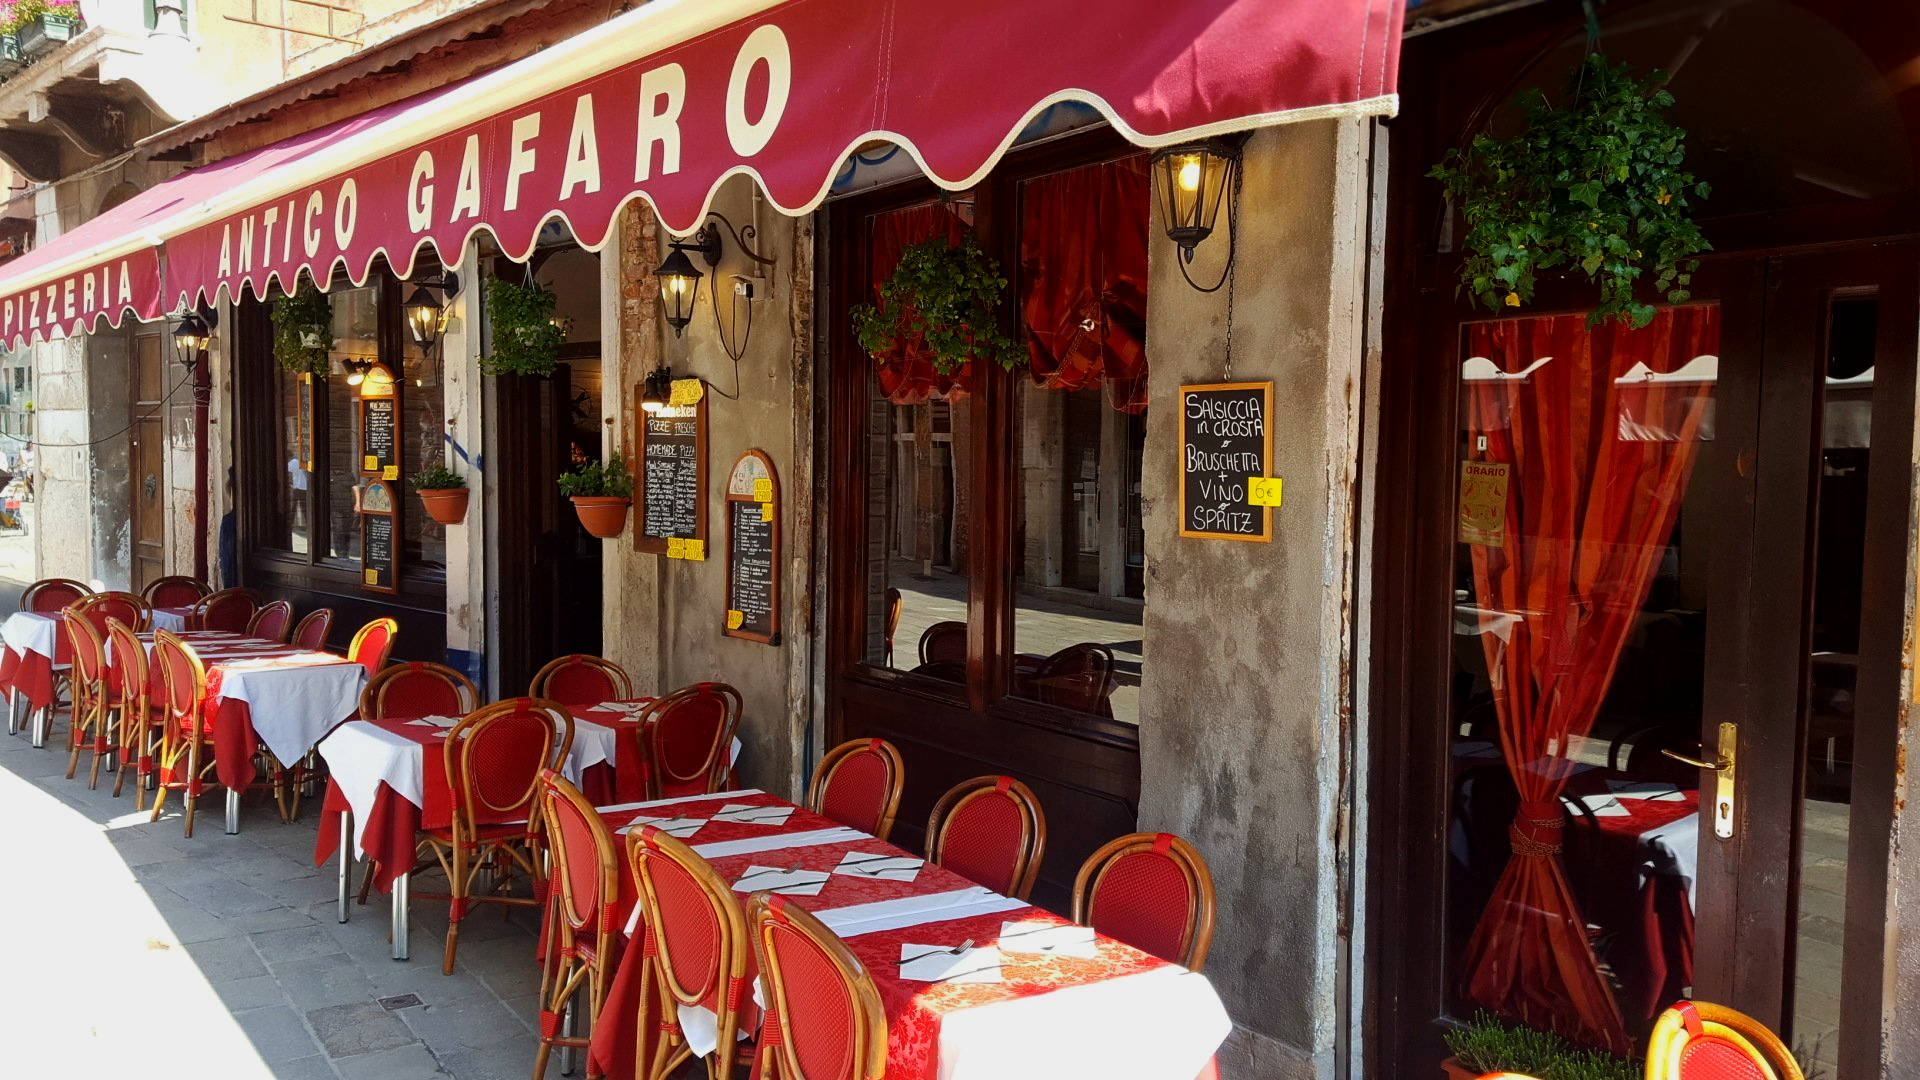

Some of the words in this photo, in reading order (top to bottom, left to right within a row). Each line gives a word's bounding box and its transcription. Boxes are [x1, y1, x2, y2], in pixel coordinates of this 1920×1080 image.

[2, 261, 133, 337] PIZZERIA
[217, 177, 358, 280] ANTICO
[407, 23, 792, 236] GAFARO
[1186, 394, 1262, 420] SALSICCIA
[1213, 419, 1264, 437] CROSTA
[647, 444, 677, 456] HOMEMADE
[679, 444, 696, 457] PIZZA
[1186, 443, 1261, 472] BRUSCHETTA
[1465, 466, 1506, 477] ORARIO
[1199, 479, 1244, 502] VINO
[1192, 505, 1254, 533] SPRITZ
